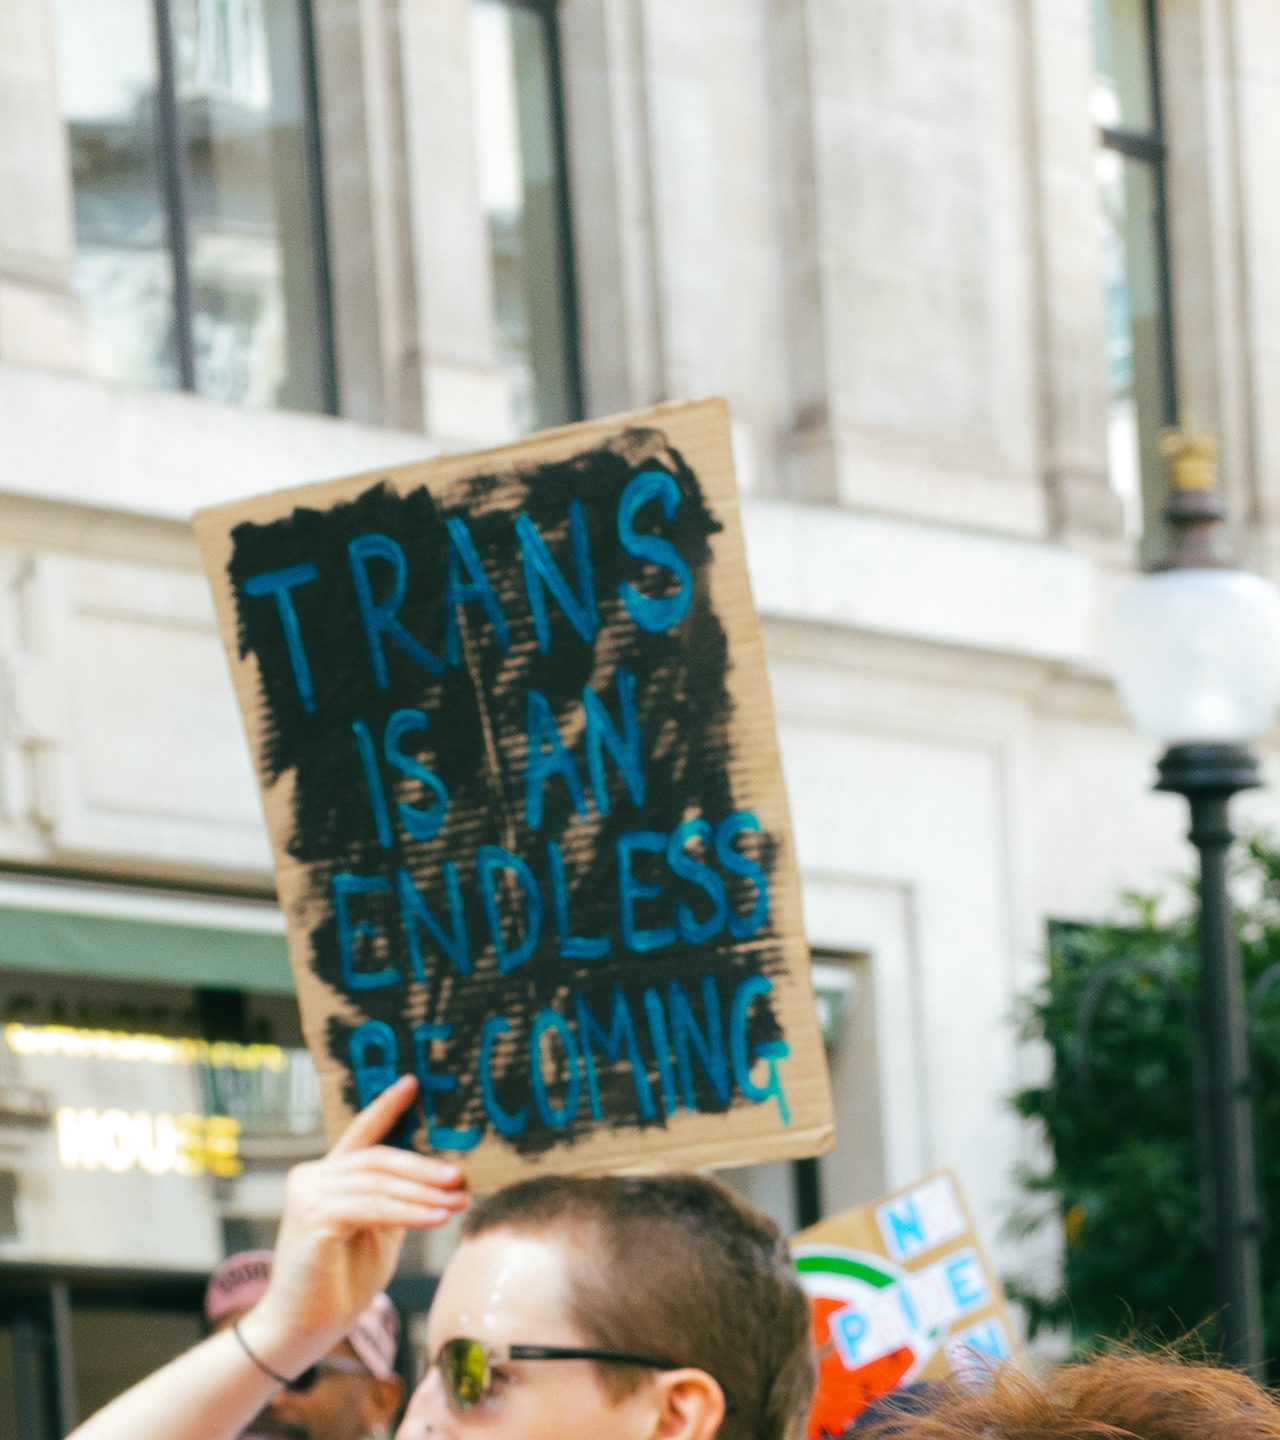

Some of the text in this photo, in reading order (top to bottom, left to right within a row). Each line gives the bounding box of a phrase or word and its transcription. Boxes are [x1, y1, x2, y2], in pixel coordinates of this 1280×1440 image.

[243, 470, 694, 714] TRANS
[352, 668, 646, 851] IS AN
[334, 811, 770, 990] ENDLESS
[348, 974, 793, 1153] BECOMING
